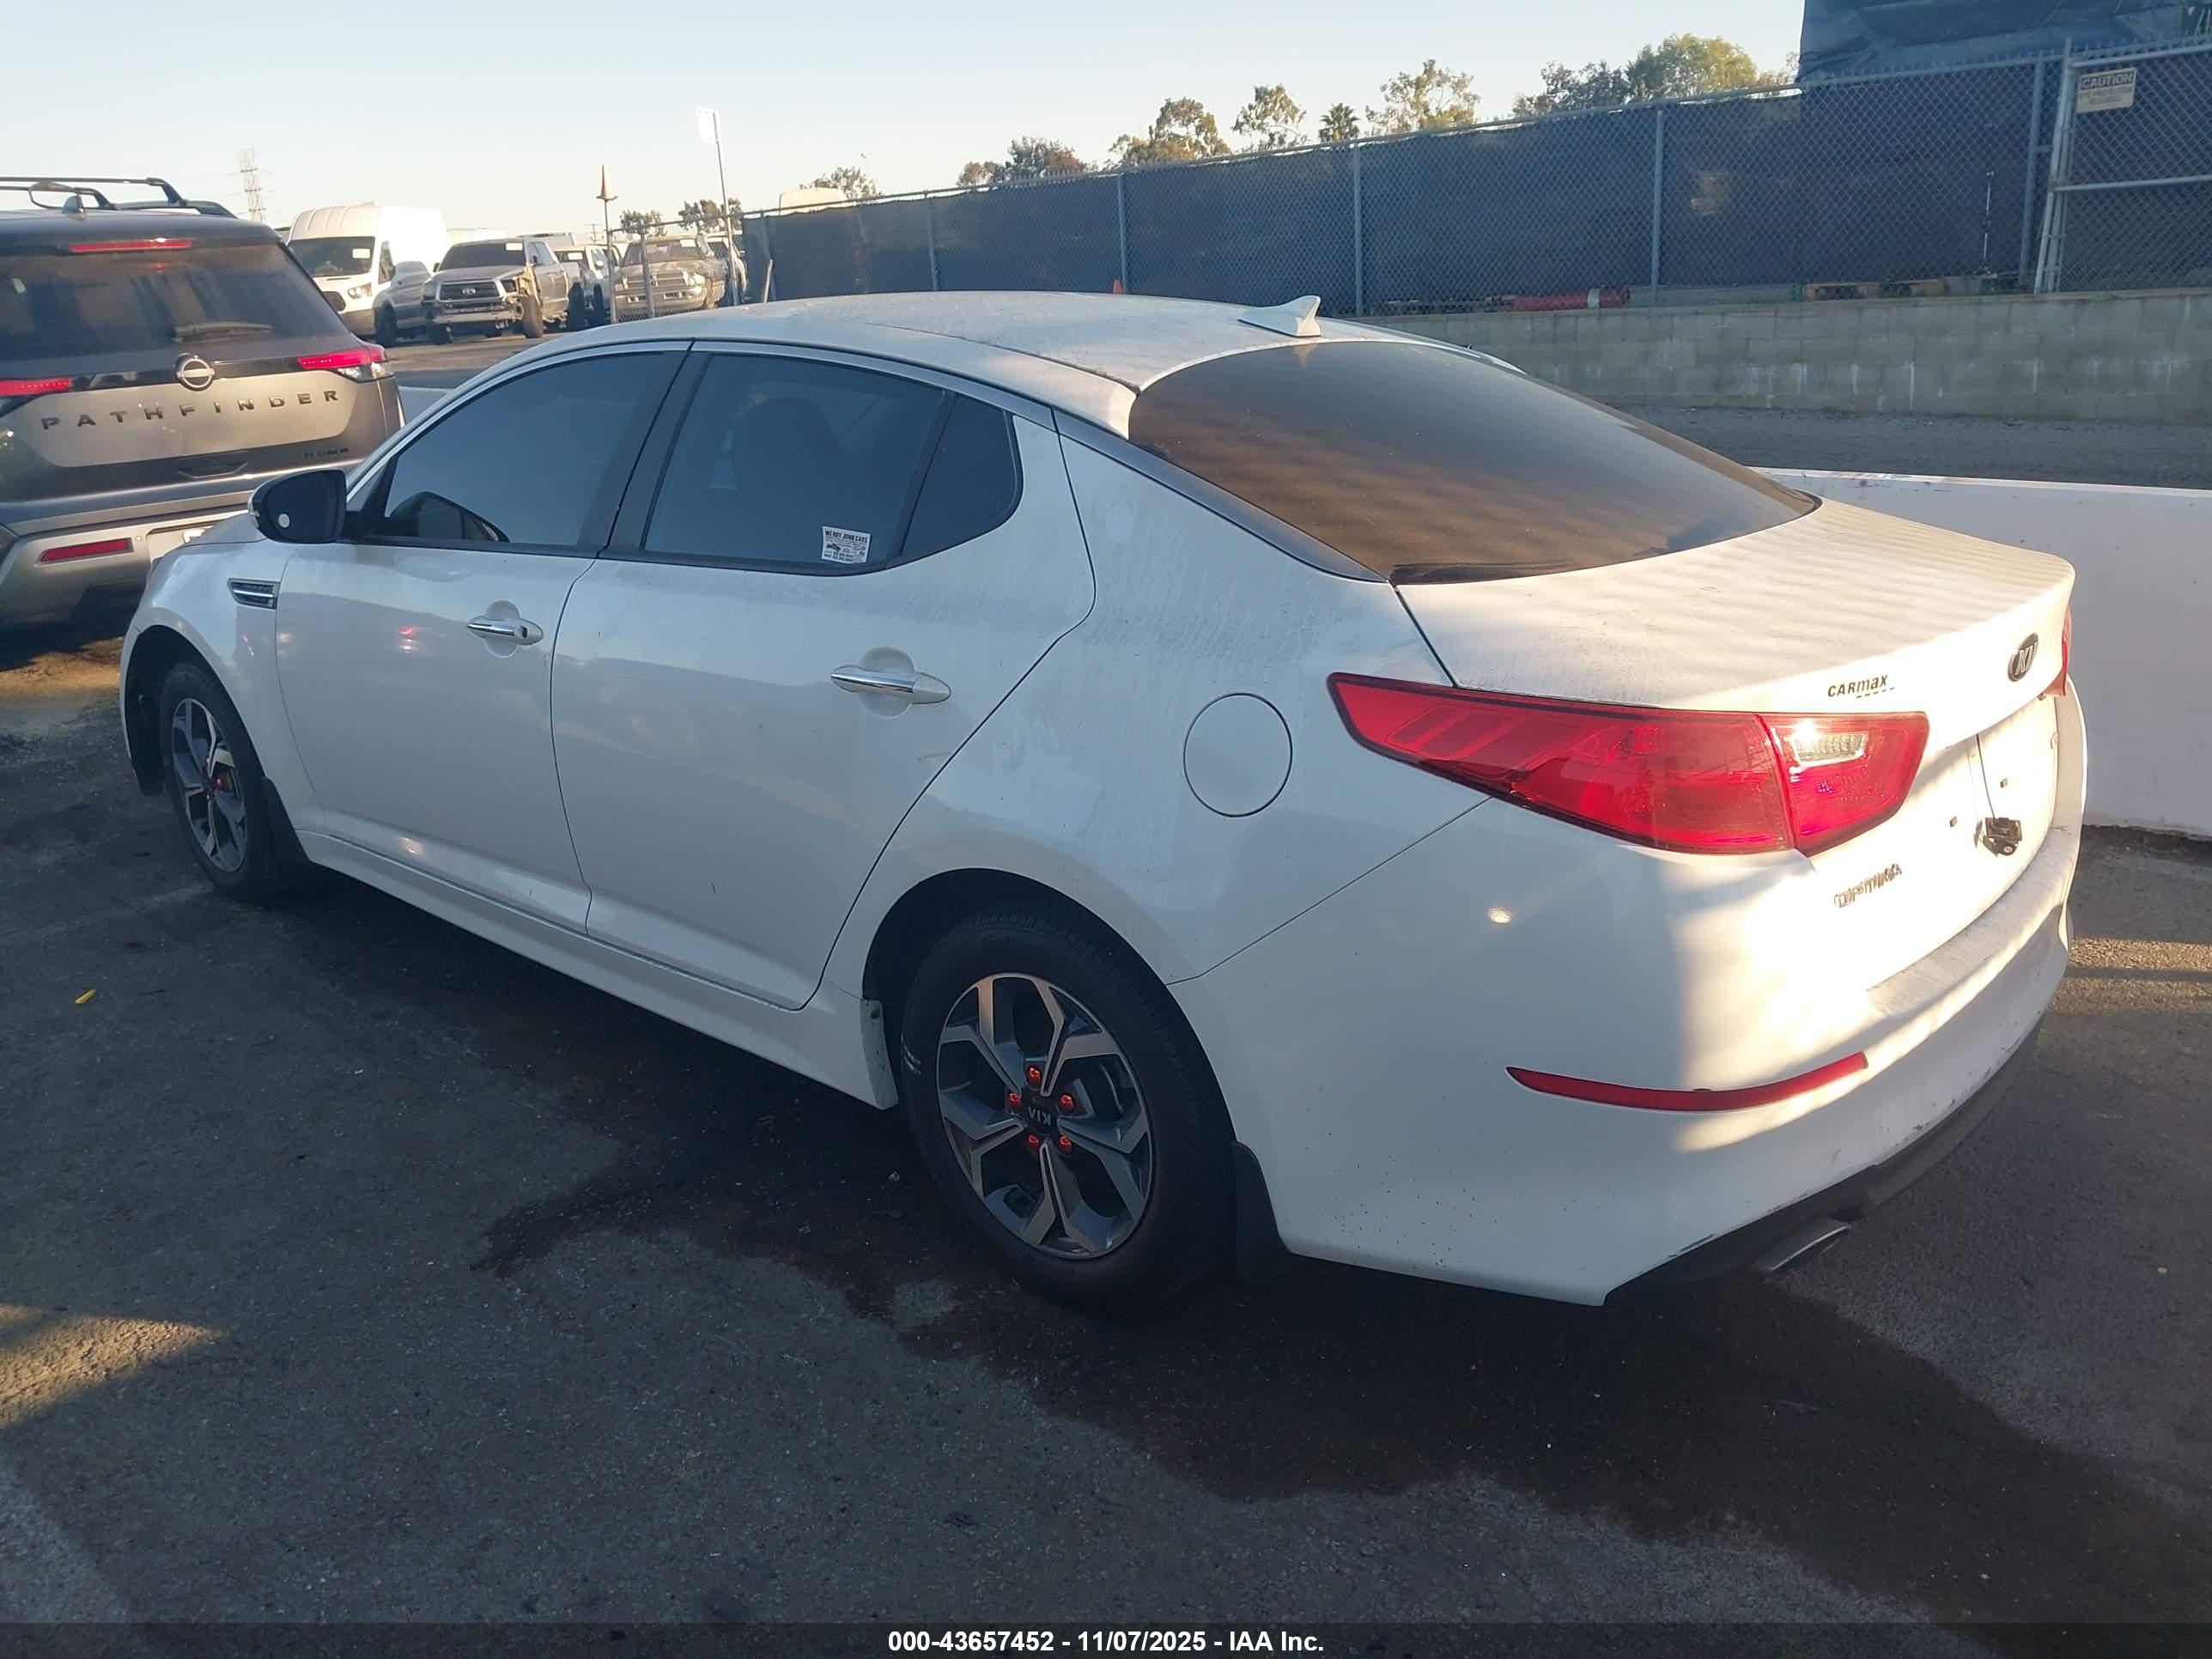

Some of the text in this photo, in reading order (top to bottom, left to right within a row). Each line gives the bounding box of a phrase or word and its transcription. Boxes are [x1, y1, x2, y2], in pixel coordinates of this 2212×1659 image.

[2081, 72, 2133, 88] CAUTION
[41, 389, 339, 429] PATHFINDER
[1834, 863, 1902, 908] OPTIMA
